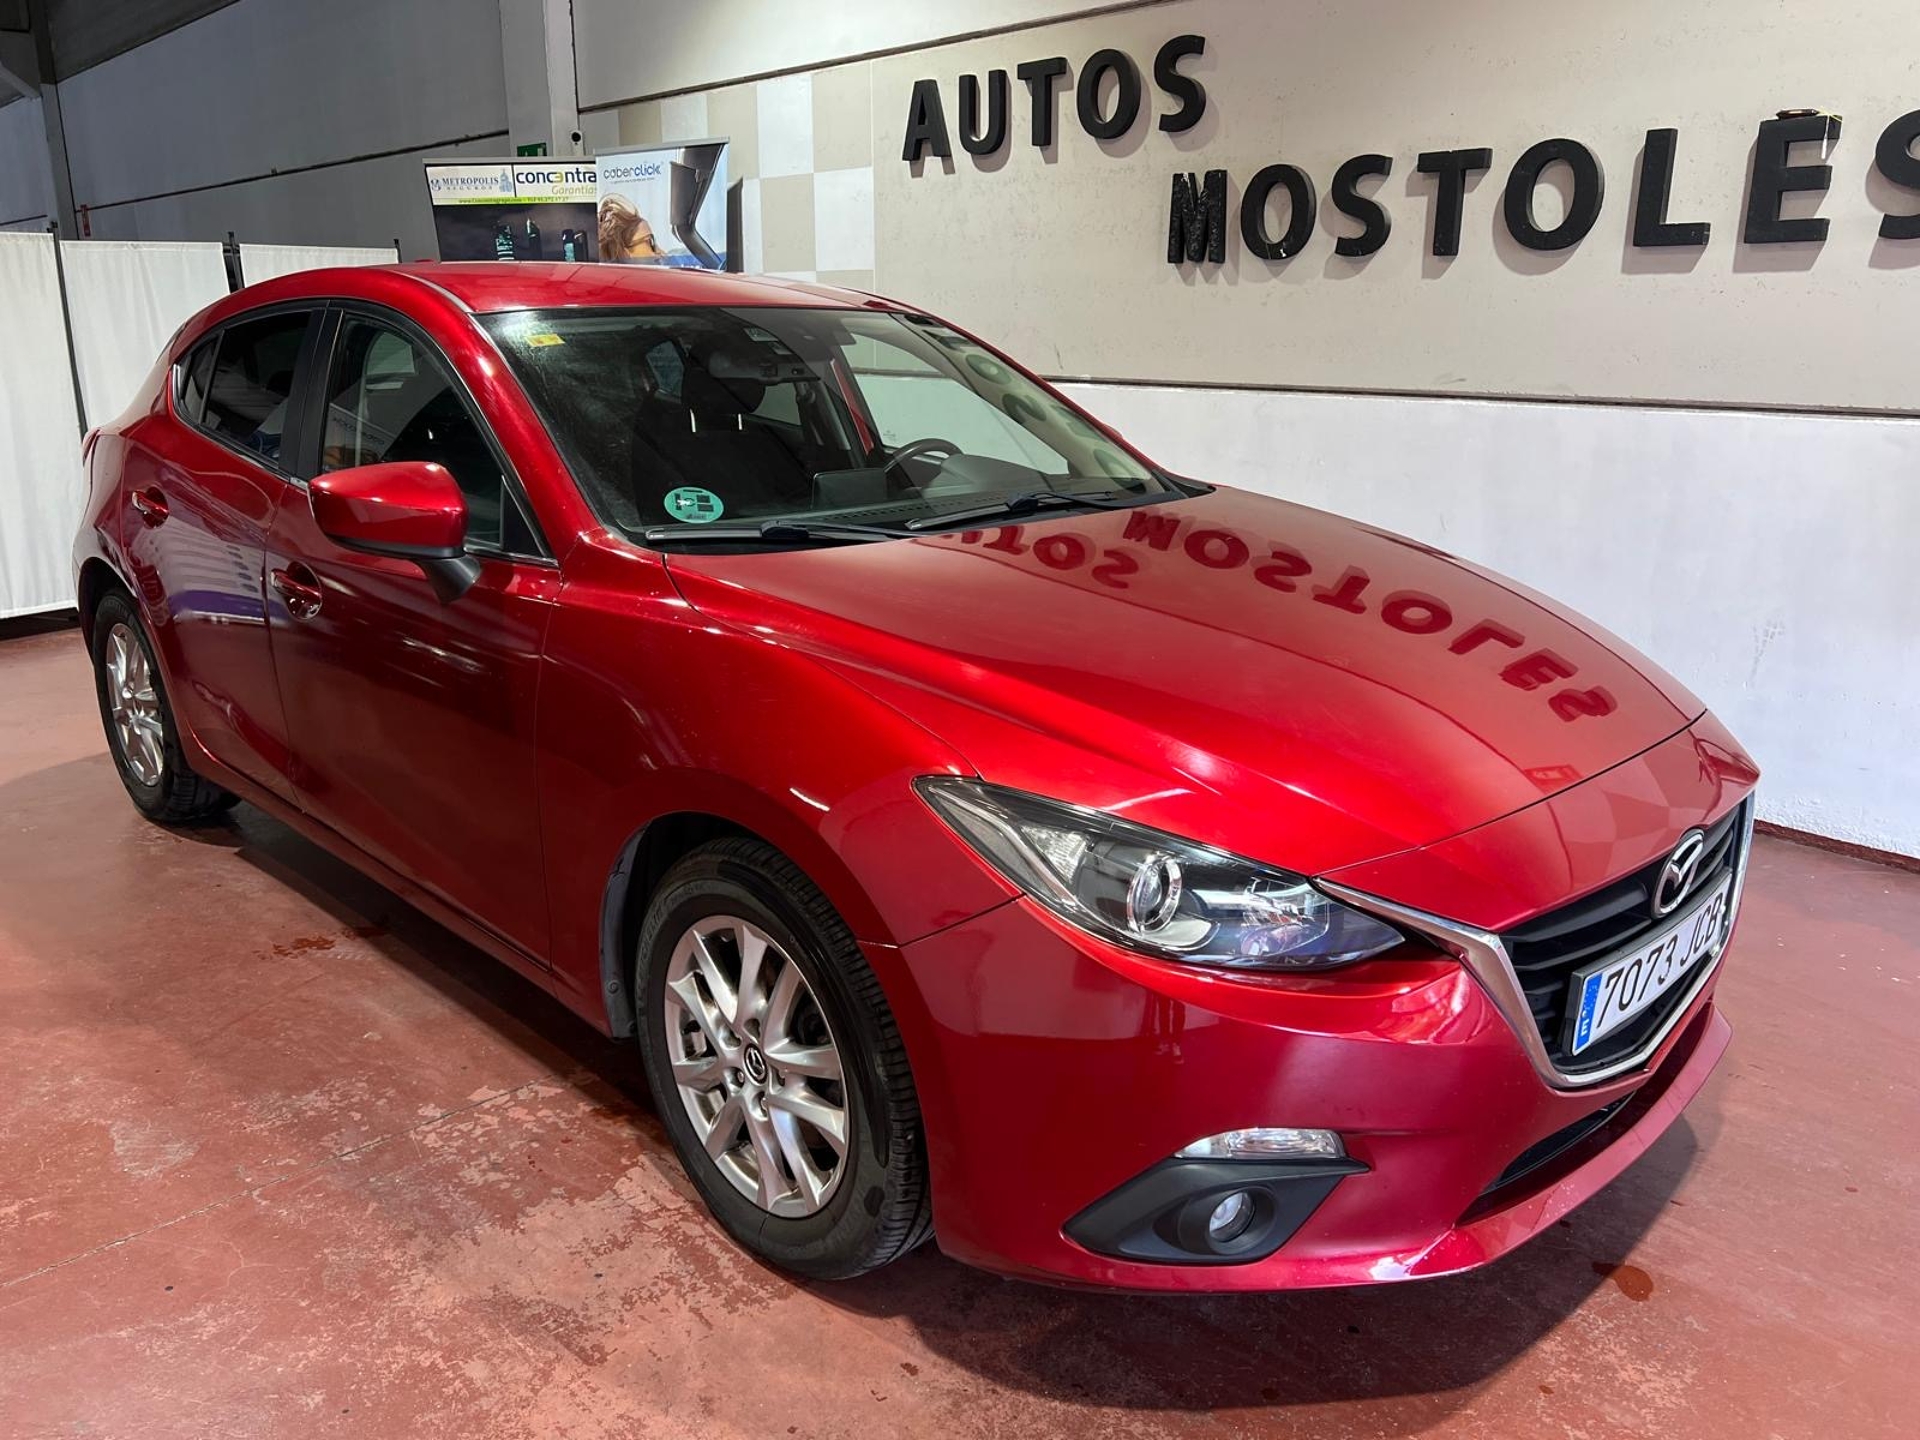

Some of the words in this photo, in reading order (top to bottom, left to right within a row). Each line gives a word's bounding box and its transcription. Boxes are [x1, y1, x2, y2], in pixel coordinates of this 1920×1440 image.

[903, 35, 1206, 166] AUTOS
[442, 177, 499, 186] METROPOLIS
[1168, 110, 1920, 264] MOSTOLES
[1596, 934, 1679, 1029] 7073
[1680, 892, 1724, 967] JCB
